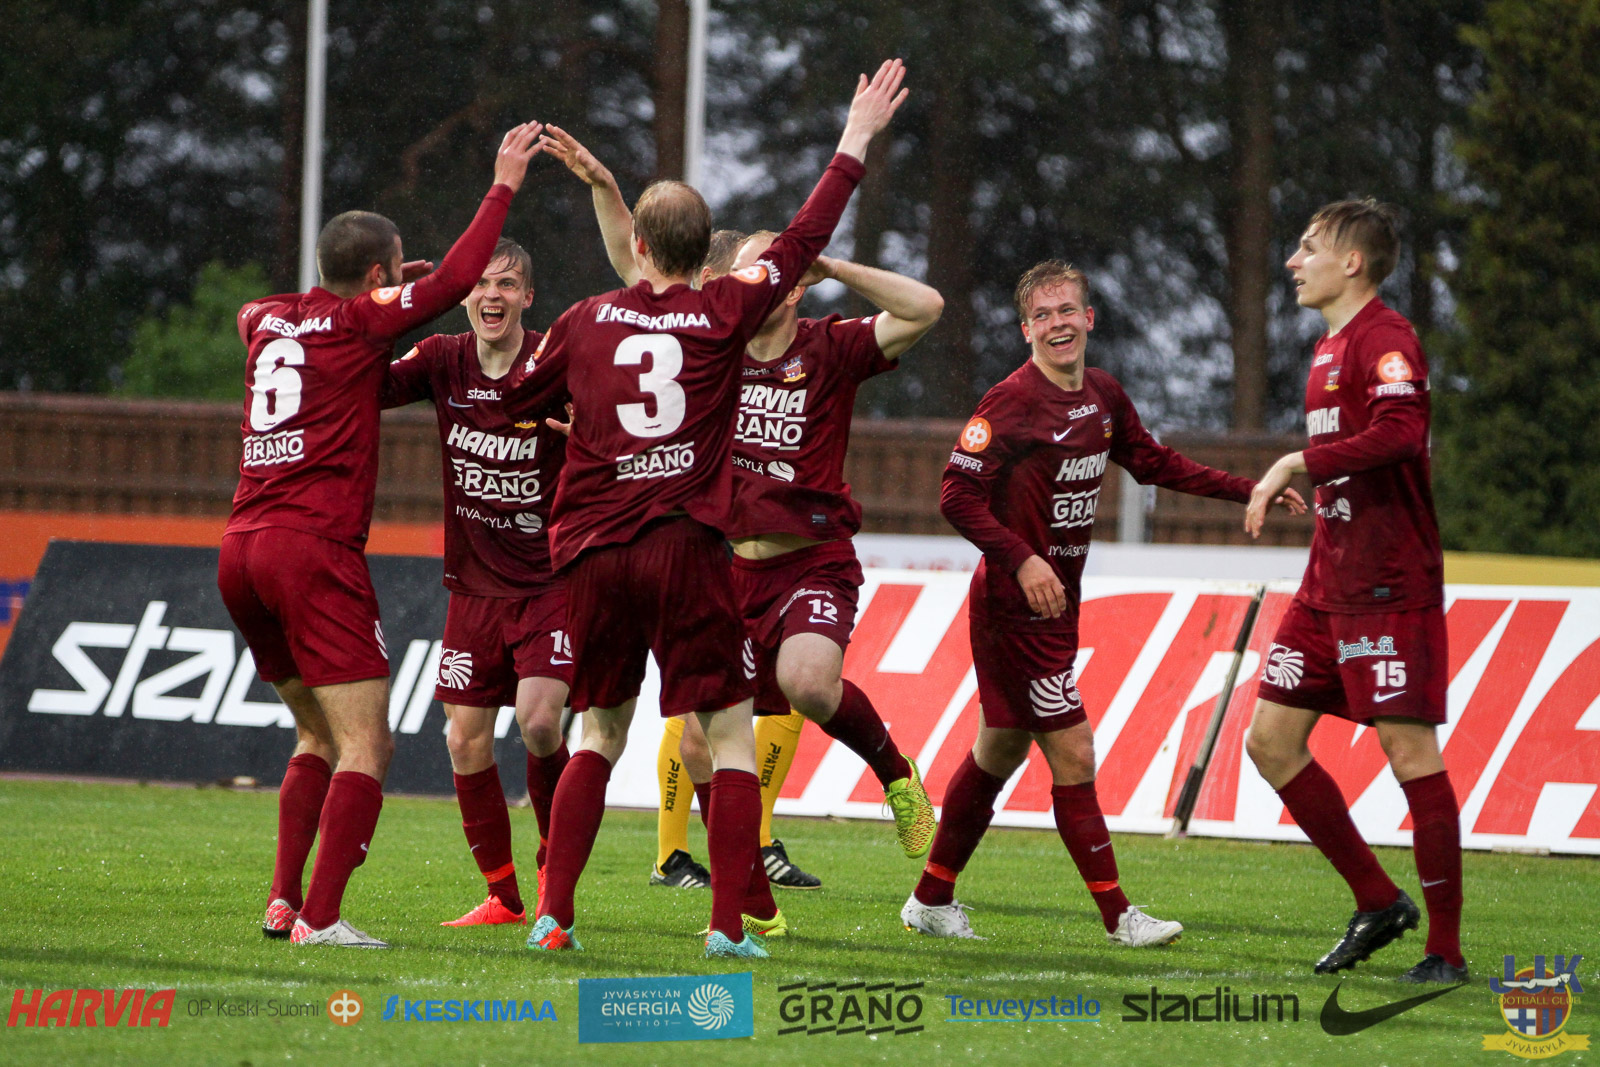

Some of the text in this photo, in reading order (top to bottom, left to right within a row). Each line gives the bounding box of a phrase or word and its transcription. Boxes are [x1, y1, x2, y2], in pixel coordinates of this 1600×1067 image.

[610, 306, 712, 330] KESKIMAA
[250, 338, 305, 432] 6
[467, 388, 502, 400] stadiu
[614, 333, 686, 438] 3
[741, 384, 808, 413] ARVIA
[243, 434, 304, 463] GRANO
[447, 423, 539, 461] HARVIA
[616, 446, 695, 475] GRANO
[808, 599, 838, 622] 12
[1337, 636, 1398, 664] jamk.fi
[1371, 660, 1407, 687] 15
